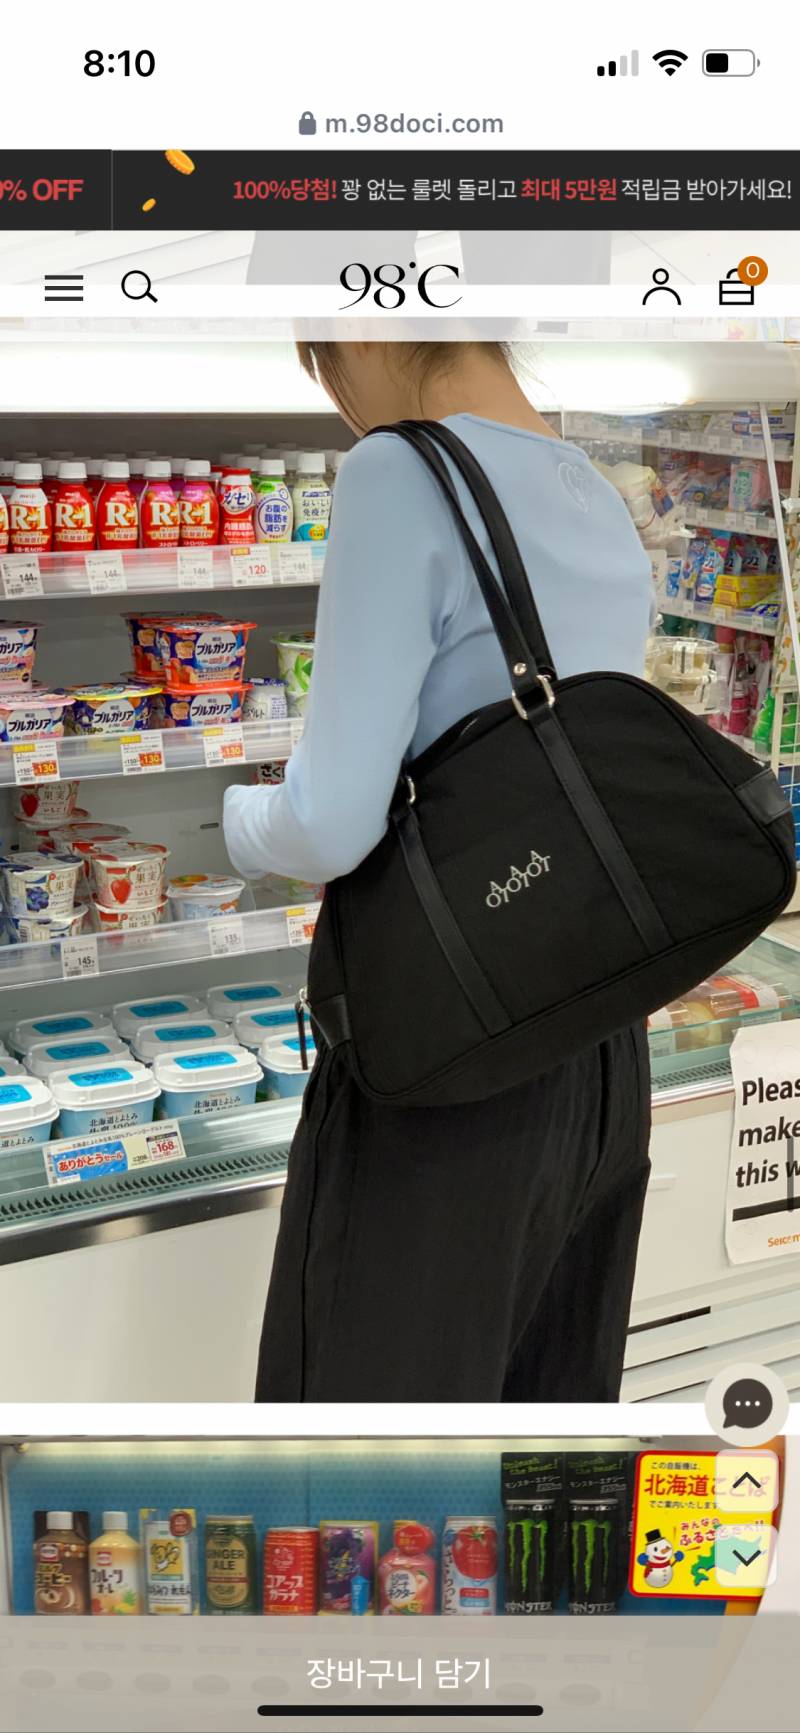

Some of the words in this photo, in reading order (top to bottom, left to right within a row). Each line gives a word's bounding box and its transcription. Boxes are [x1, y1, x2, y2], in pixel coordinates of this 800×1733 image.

[84, 50, 155, 77] 8:10
[326, 113, 503, 134] m.98doci.com
[33, 178, 84, 201] OFF
[233, 178, 337, 201] 100%당첨!
[342, 178, 361, 201] 꽝
[367, 178, 407, 201] 없는
[412, 178, 452, 201] 룰렛
[457, 178, 517, 201] 돌리고
[521, 178, 561, 201] 최대
[565, 178, 617, 201] 5만원
[621, 178, 681, 201] 적립금
[687, 178, 792, 201] 받아가세요!
[747, 262, 760, 279] 0
[10, 504, 48, 530] R-1
[55, 502, 93, 528] R-1
[249, 564, 267, 575] 120
[197, 641, 236, 655] ブルガリア
[94, 710, 134, 724] ブルガリア
[191, 703, 232, 717] ブルガリア
[8, 718, 52, 733] ブルガリア
[738, 1115, 800, 1147] make
[156, 1141, 174, 1153] 168
[735, 1159, 779, 1188] this
[213, 1561, 236, 1571] ALE
[307, 1658, 422, 1689] 장바구니
[436, 1658, 490, 1689] 담기
